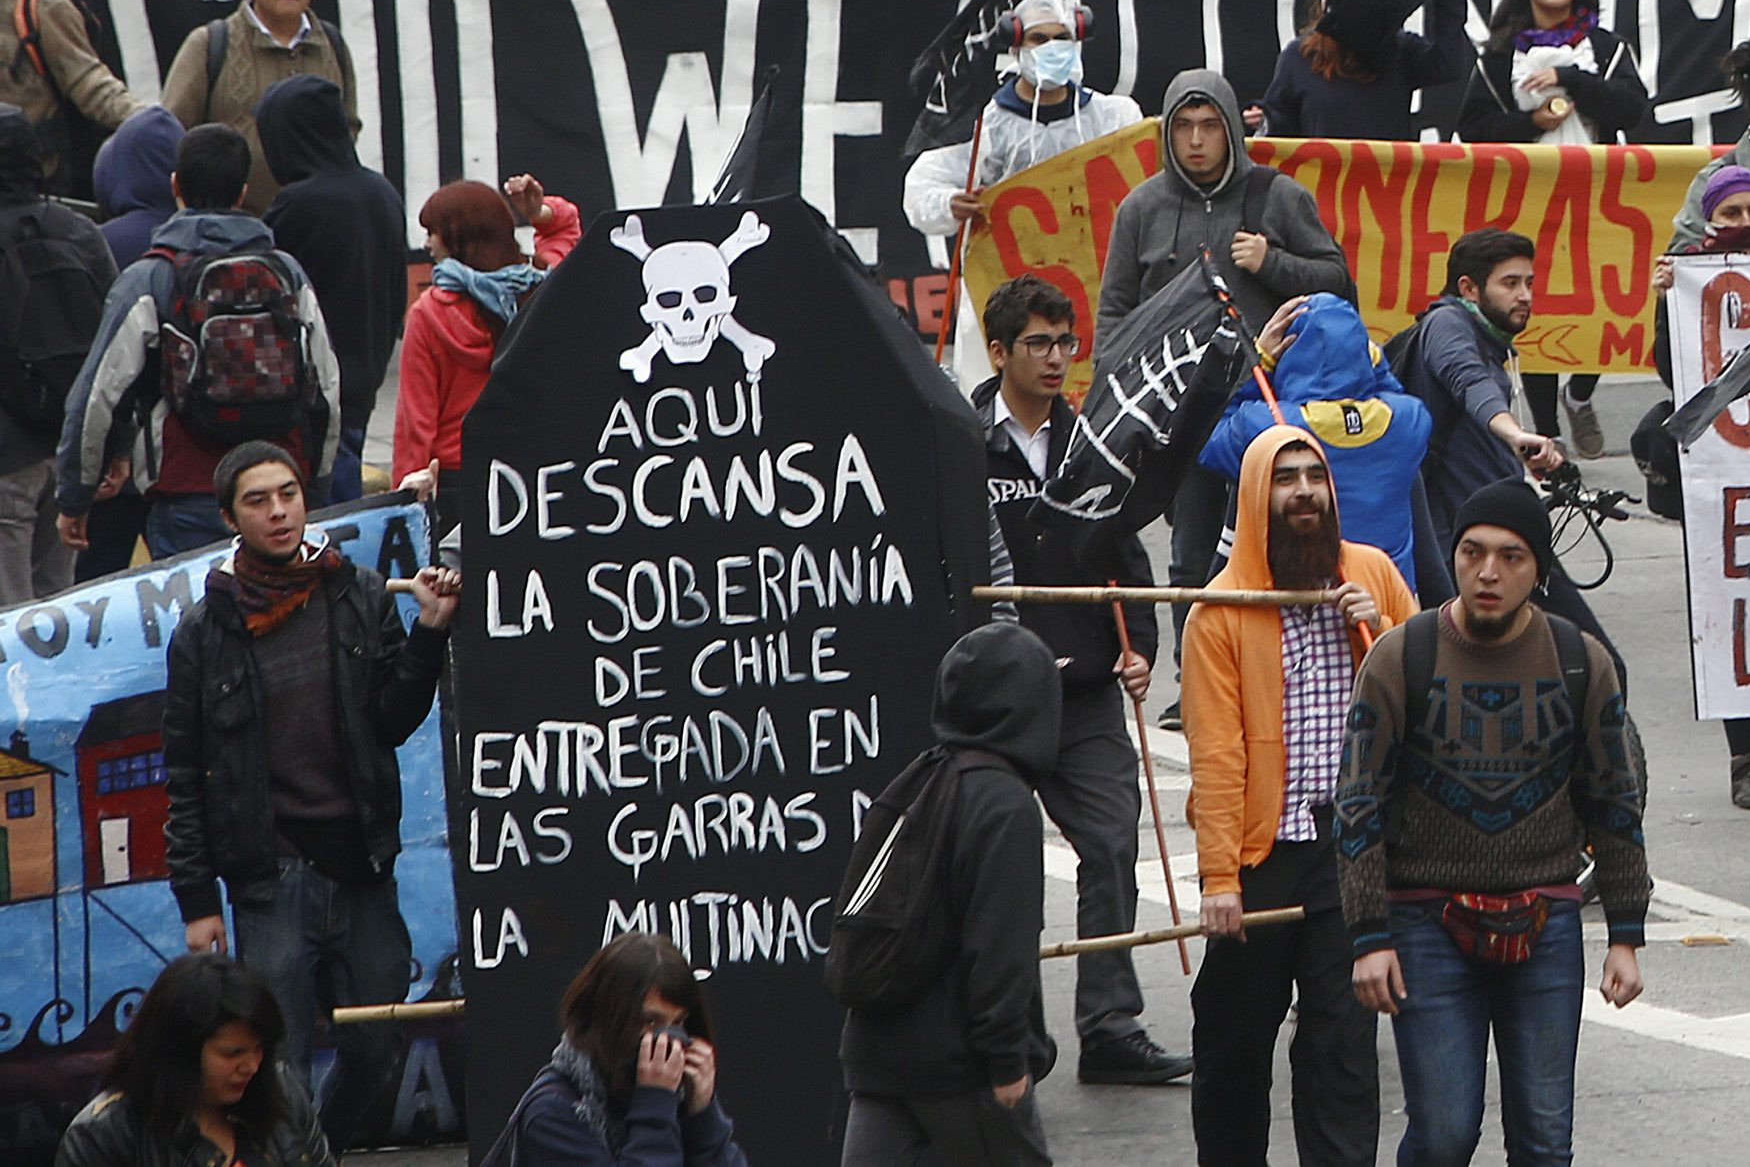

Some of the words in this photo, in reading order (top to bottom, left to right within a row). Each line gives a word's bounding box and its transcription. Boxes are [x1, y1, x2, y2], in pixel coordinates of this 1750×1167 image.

[487, 433, 886, 540] DESCANSA
[486, 568, 556, 639] LA
[594, 646, 669, 708] DE
[471, 707, 787, 799] ENTREGADA
[809, 694, 882, 776] EN
[468, 808, 574, 873] LAS
[607, 791, 828, 884] GARRAS
[472, 906, 530, 970] LA
